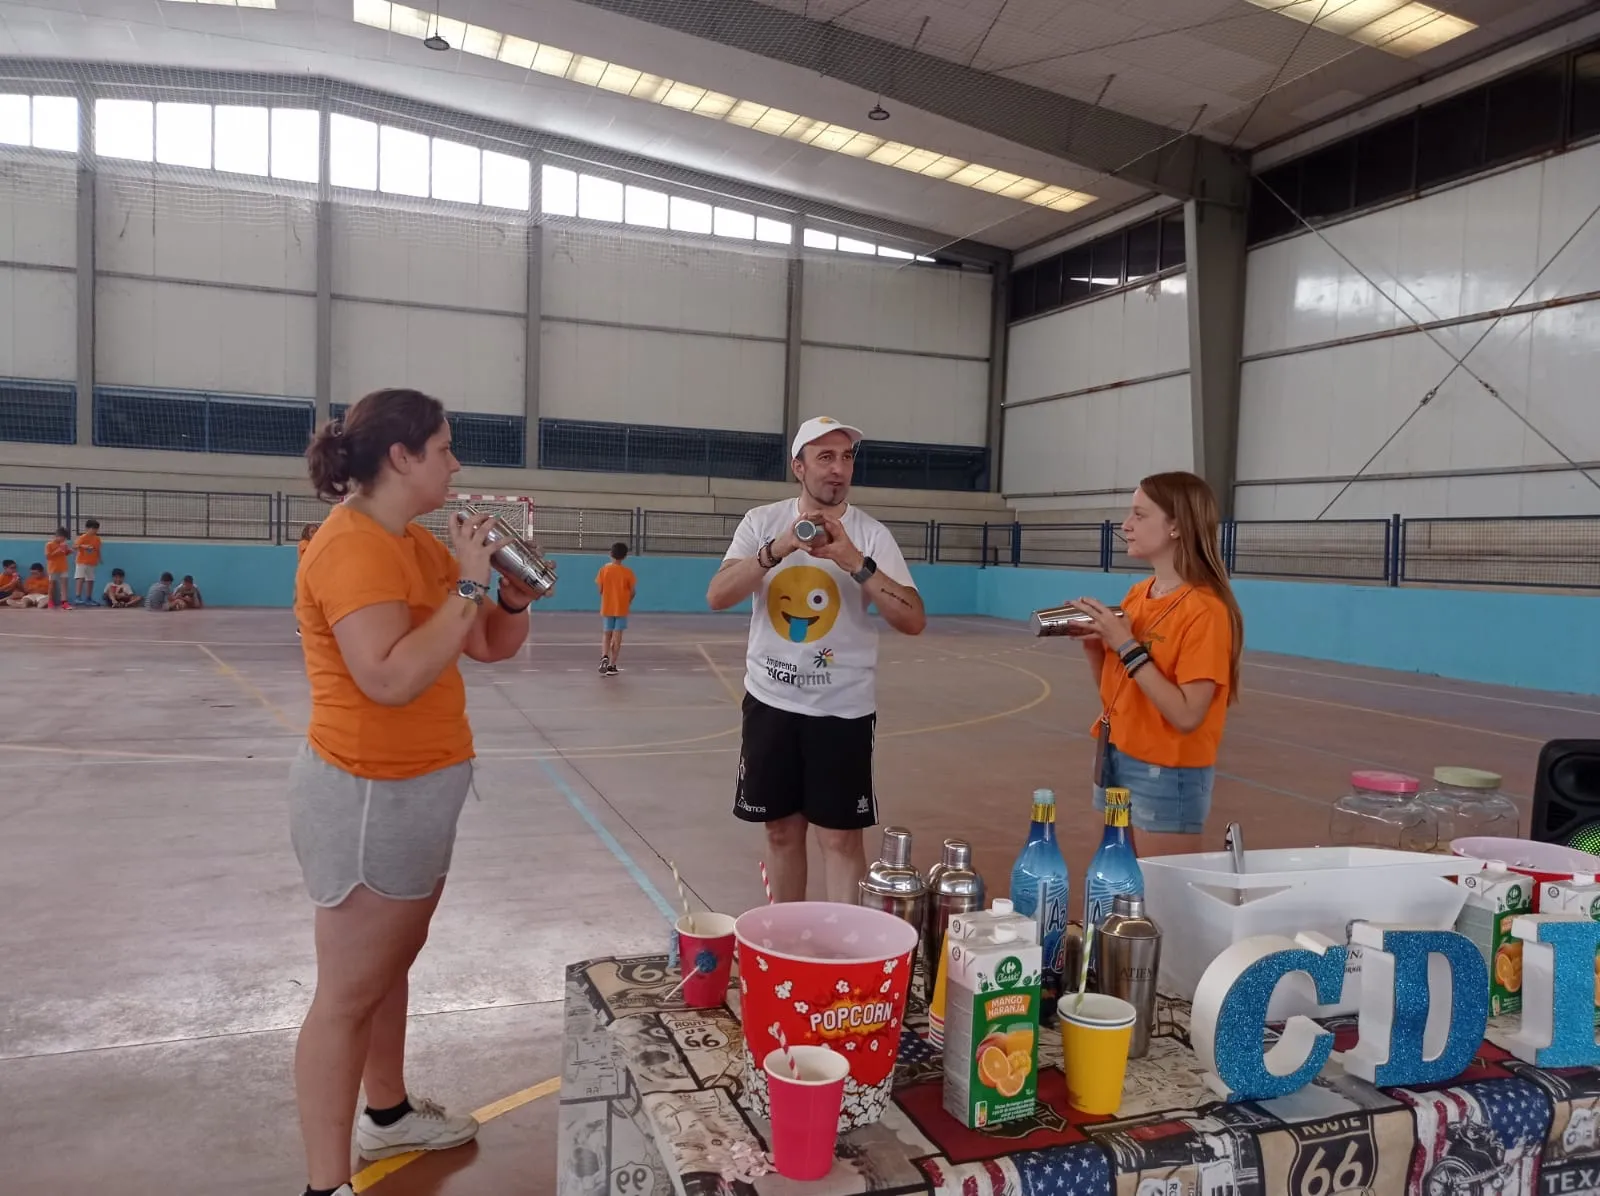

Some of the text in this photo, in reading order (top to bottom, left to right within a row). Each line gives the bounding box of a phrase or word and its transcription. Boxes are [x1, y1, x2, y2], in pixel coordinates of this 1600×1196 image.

[991, 995, 1023, 1007] MANGO
[810, 1002, 893, 1032] POPCORN
[988, 1003, 1025, 1018] NARANJA
[674, 1019, 709, 1029] ROUTE
[684, 1034, 721, 1048] 66
[1301, 1140, 1363, 1196] 66
